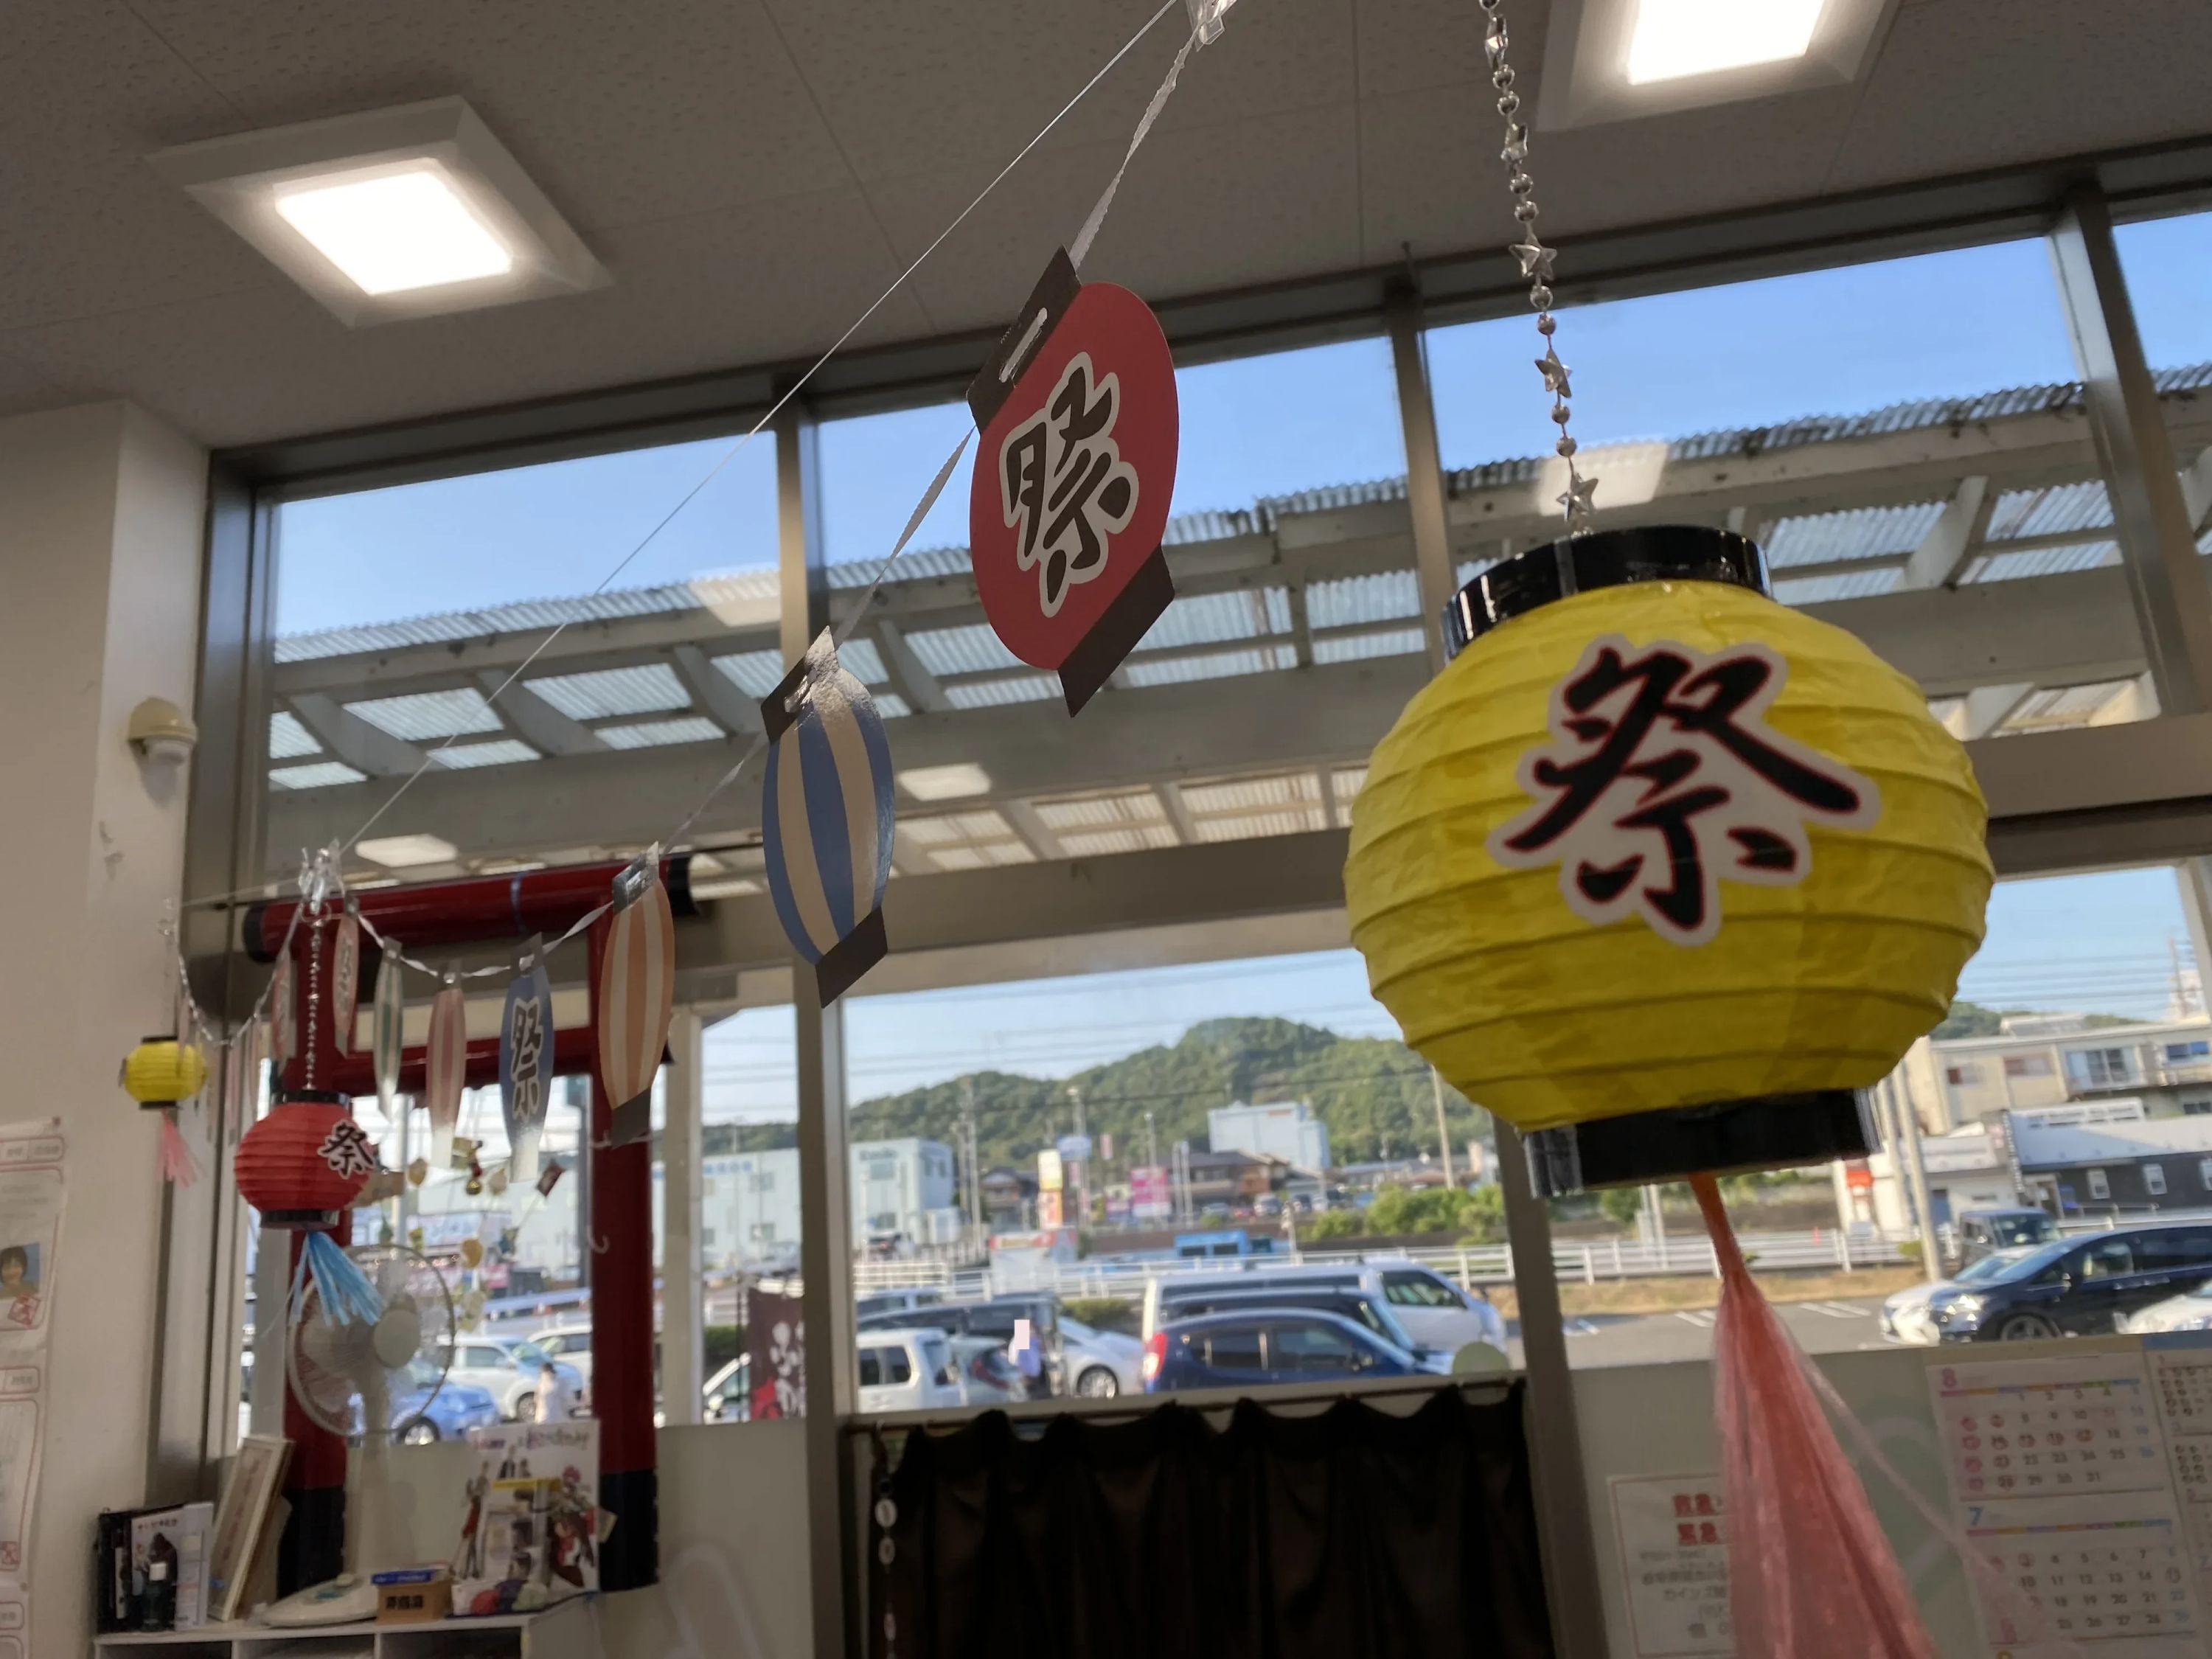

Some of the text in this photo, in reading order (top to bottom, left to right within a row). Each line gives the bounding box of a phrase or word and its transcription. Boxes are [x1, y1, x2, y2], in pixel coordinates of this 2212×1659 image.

[1003, 360, 1135, 611] 祭
[1497, 641, 1869, 936] 祭
[512, 998, 542, 1119] 祭
[319, 1120, 375, 1178] 祭
[1942, 1368, 1957, 1388] 8
[2108, 1430, 2121, 1439] 18
[2053, 1453, 2067, 1463] 23
[2080, 1451, 2096, 1461] 24
[2110, 1450, 2125, 1459] 25
[2028, 1476, 2042, 1486] 29
[2057, 1474, 2072, 1484] 30
[2087, 1472, 2100, 1482] 31
[1969, 1507, 1983, 1526] 7
[2051, 1555, 2059, 1563] 4
[2081, 1554, 2089, 1562] 5
[2110, 1552, 2118, 1561] 6
[2139, 1550, 2146, 1559] 7
[2052, 1576, 2064, 1585] 11
[2079, 1575, 2093, 1584] 12
[2109, 1573, 2123, 1582] 13
[2138, 1571, 2152, 1580] 14
[2056, 1598, 2067, 1607] 18
[2112, 1594, 2126, 1604] 20
[2142, 1593, 2157, 1602] 21
[2057, 1619, 2072, 1629] 25
[2087, 1618, 2101, 1627] 26
[2118, 1616, 2131, 1625] 27
[2146, 1614, 2161, 1624] 28
